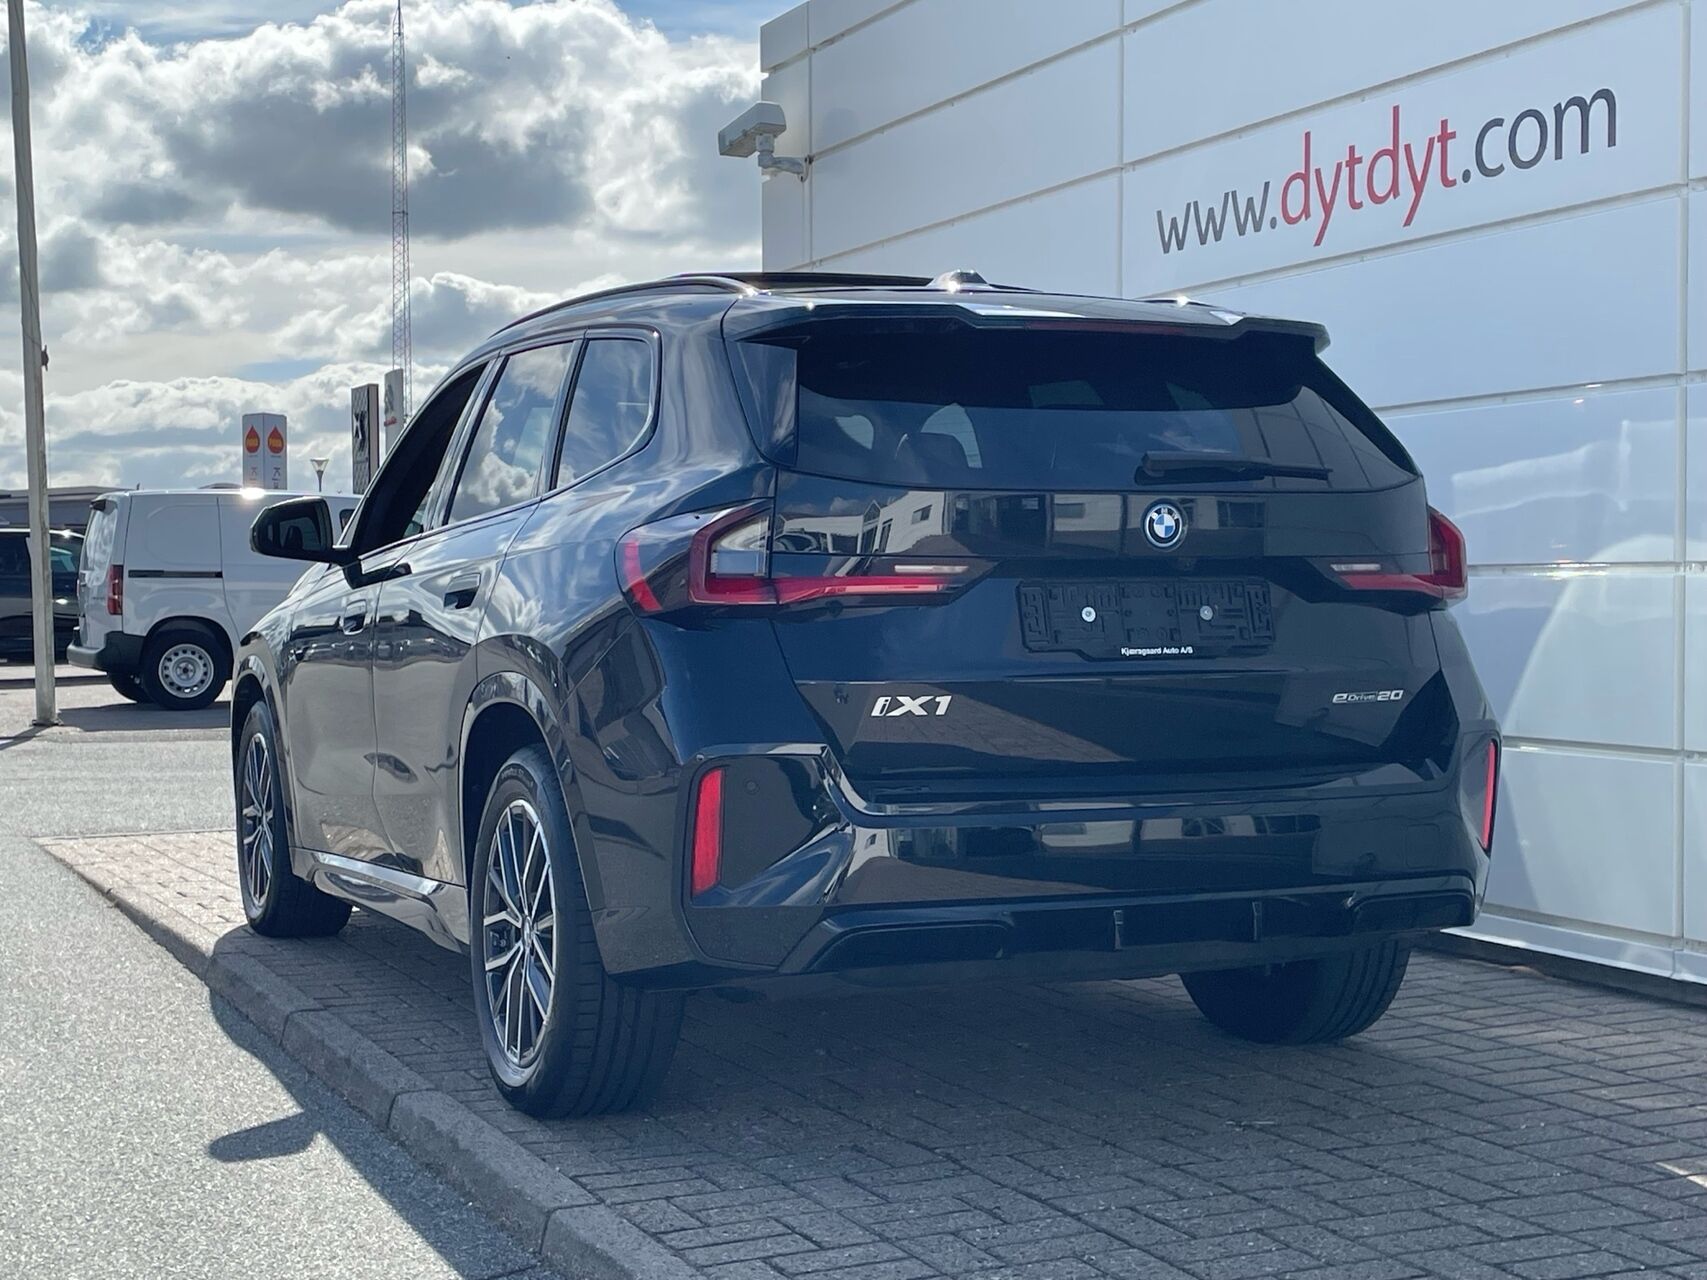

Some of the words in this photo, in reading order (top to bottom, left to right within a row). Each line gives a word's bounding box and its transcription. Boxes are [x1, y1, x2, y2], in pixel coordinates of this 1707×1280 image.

[1156, 88, 1617, 254] www.dytdyt.com
[1163, 646, 1180, 655] Auto
[871, 695, 952, 717] iX1
